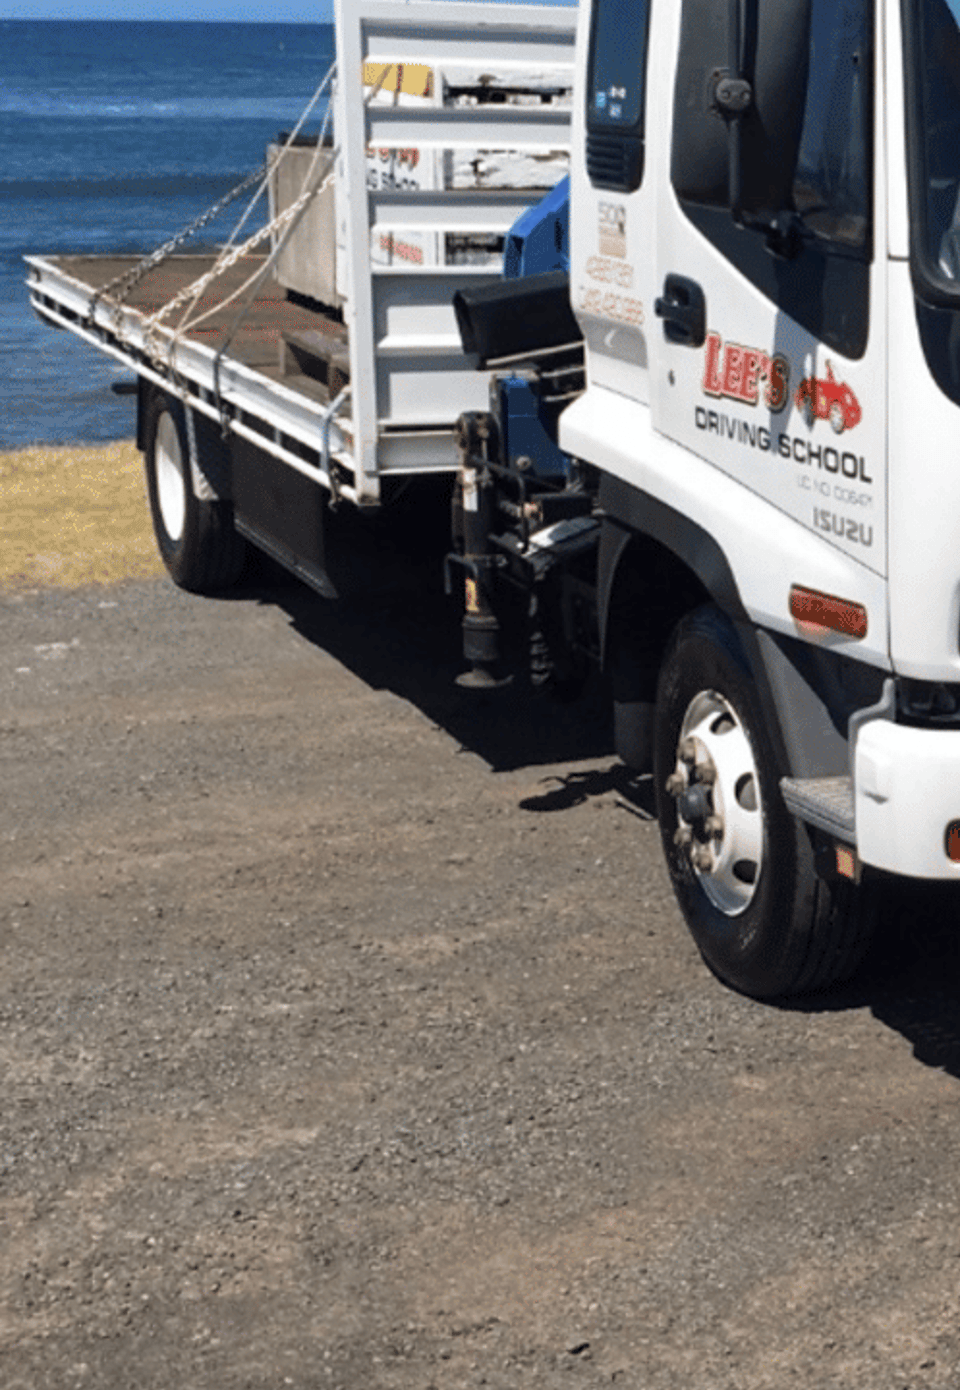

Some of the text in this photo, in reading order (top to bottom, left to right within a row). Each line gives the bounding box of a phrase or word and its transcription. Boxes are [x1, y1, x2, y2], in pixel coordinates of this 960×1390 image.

[703, 331, 791, 415] LEE'S
[694, 406, 874, 484] DRIVING SCHOOL
[813, 506, 873, 547] ISUZU
